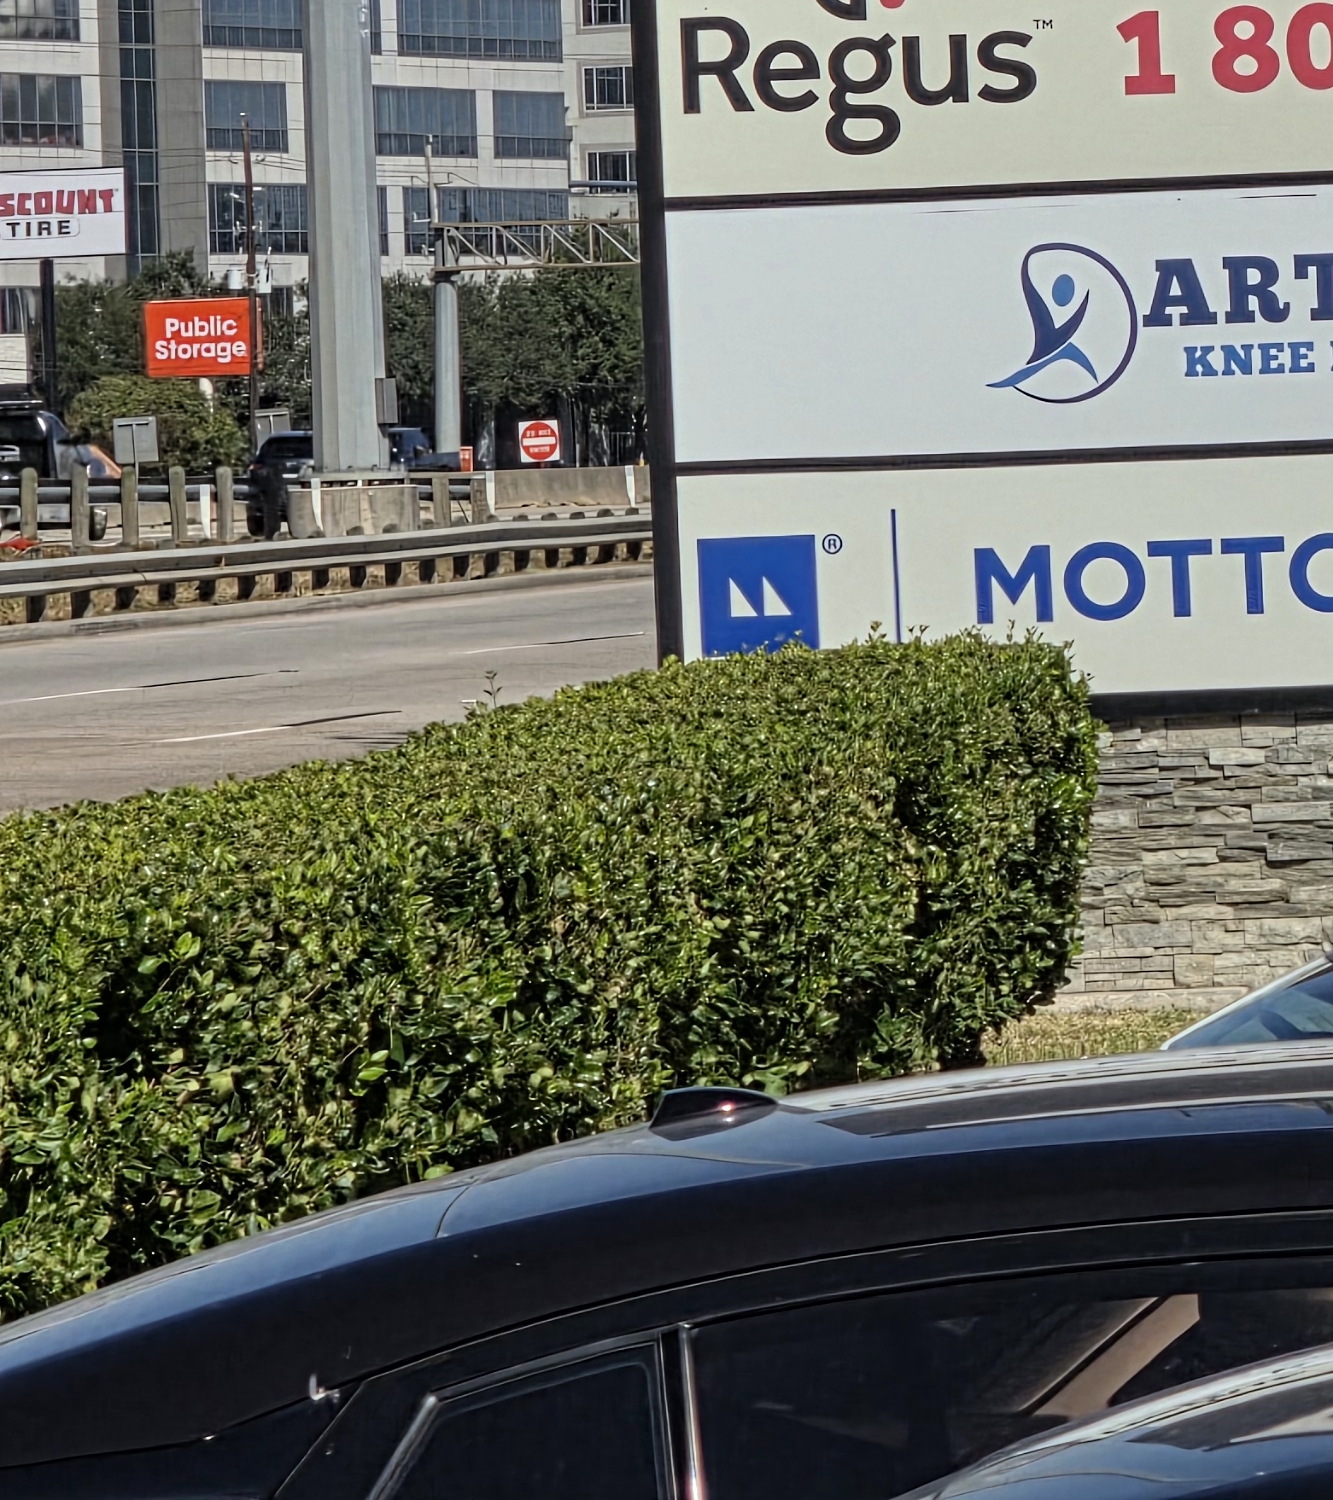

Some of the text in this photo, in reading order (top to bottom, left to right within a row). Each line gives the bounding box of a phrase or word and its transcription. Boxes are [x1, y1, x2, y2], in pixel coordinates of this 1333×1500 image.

[680, 16, 1037, 155] Regus
[1117, 10, 1176, 97] 1
[6, 220, 71, 238] TIRE
[165, 315, 238, 338] Public
[155, 340, 247, 363] Storage
[1184, 340, 1316, 378] KNEE
